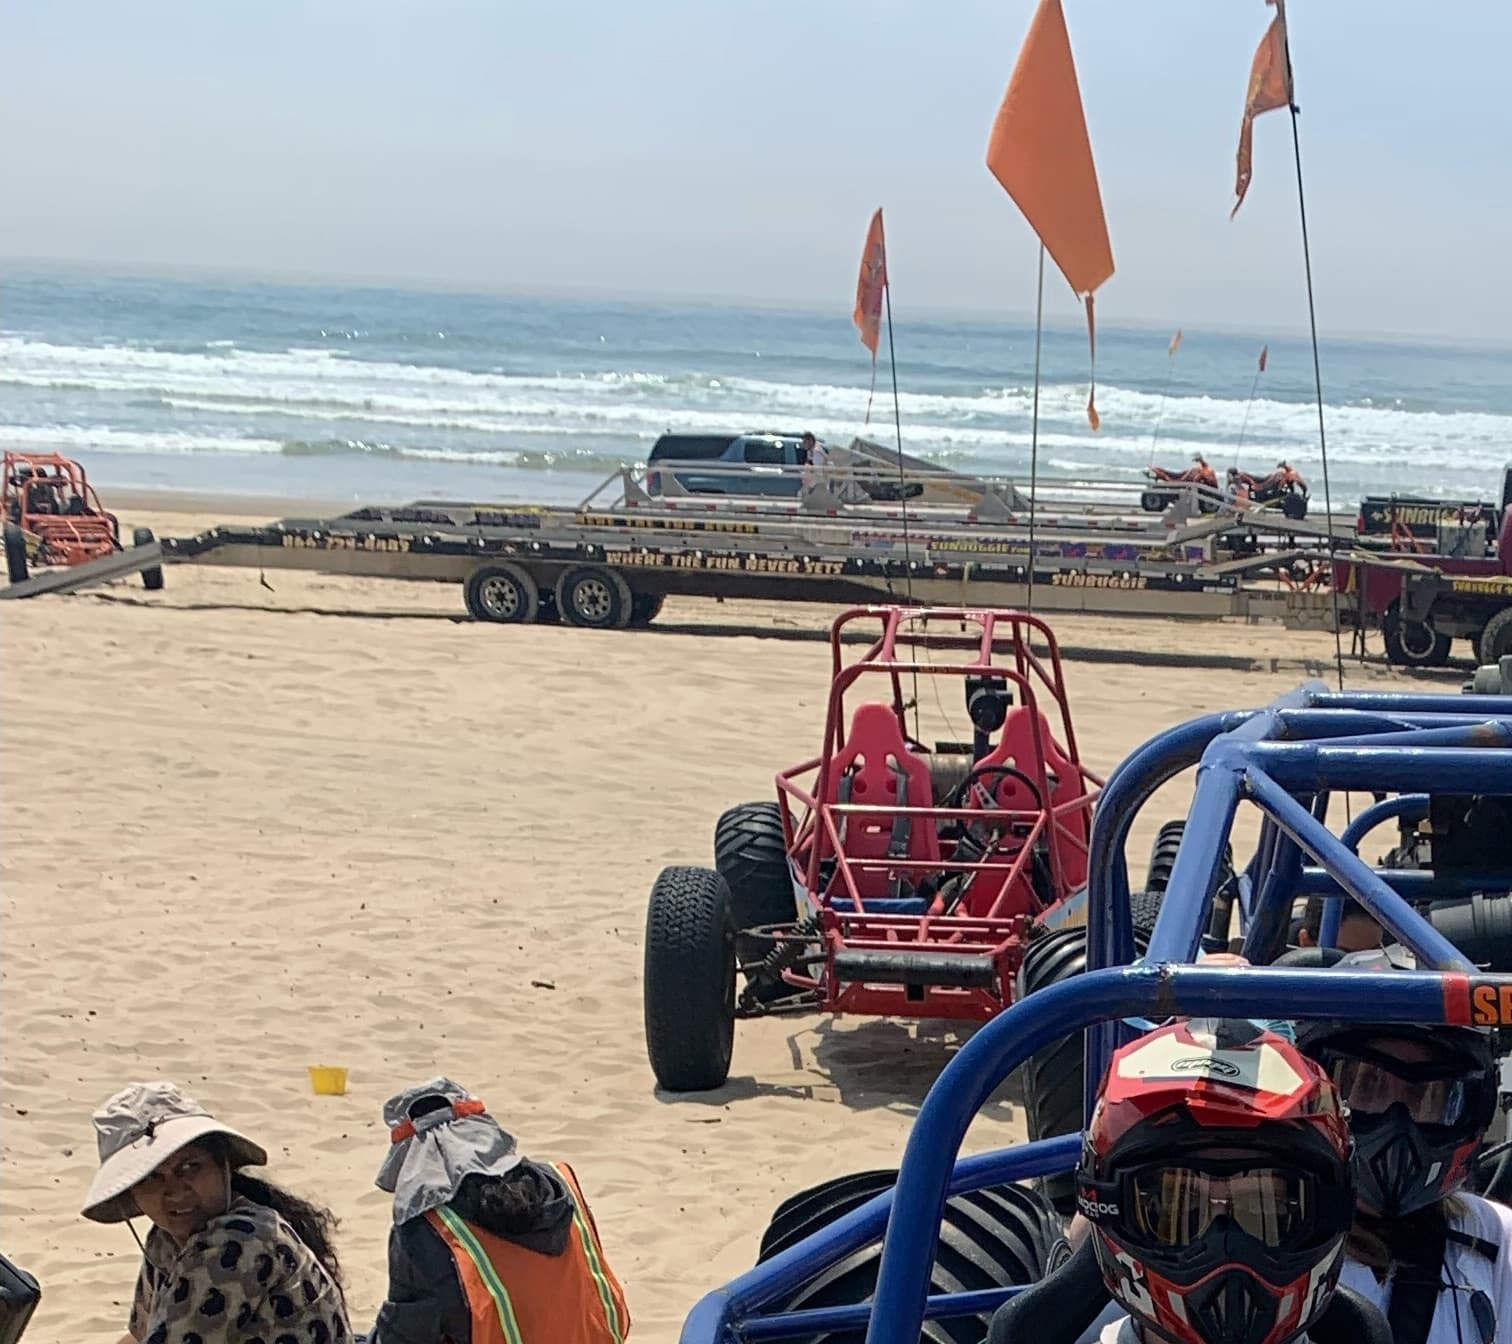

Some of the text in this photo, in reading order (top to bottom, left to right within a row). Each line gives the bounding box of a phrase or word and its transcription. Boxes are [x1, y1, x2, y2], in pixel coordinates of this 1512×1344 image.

[607, 551, 843, 575] WHERE THE FUN NEVER SETS
[1052, 573, 1148, 590] SUNBUGGIE
